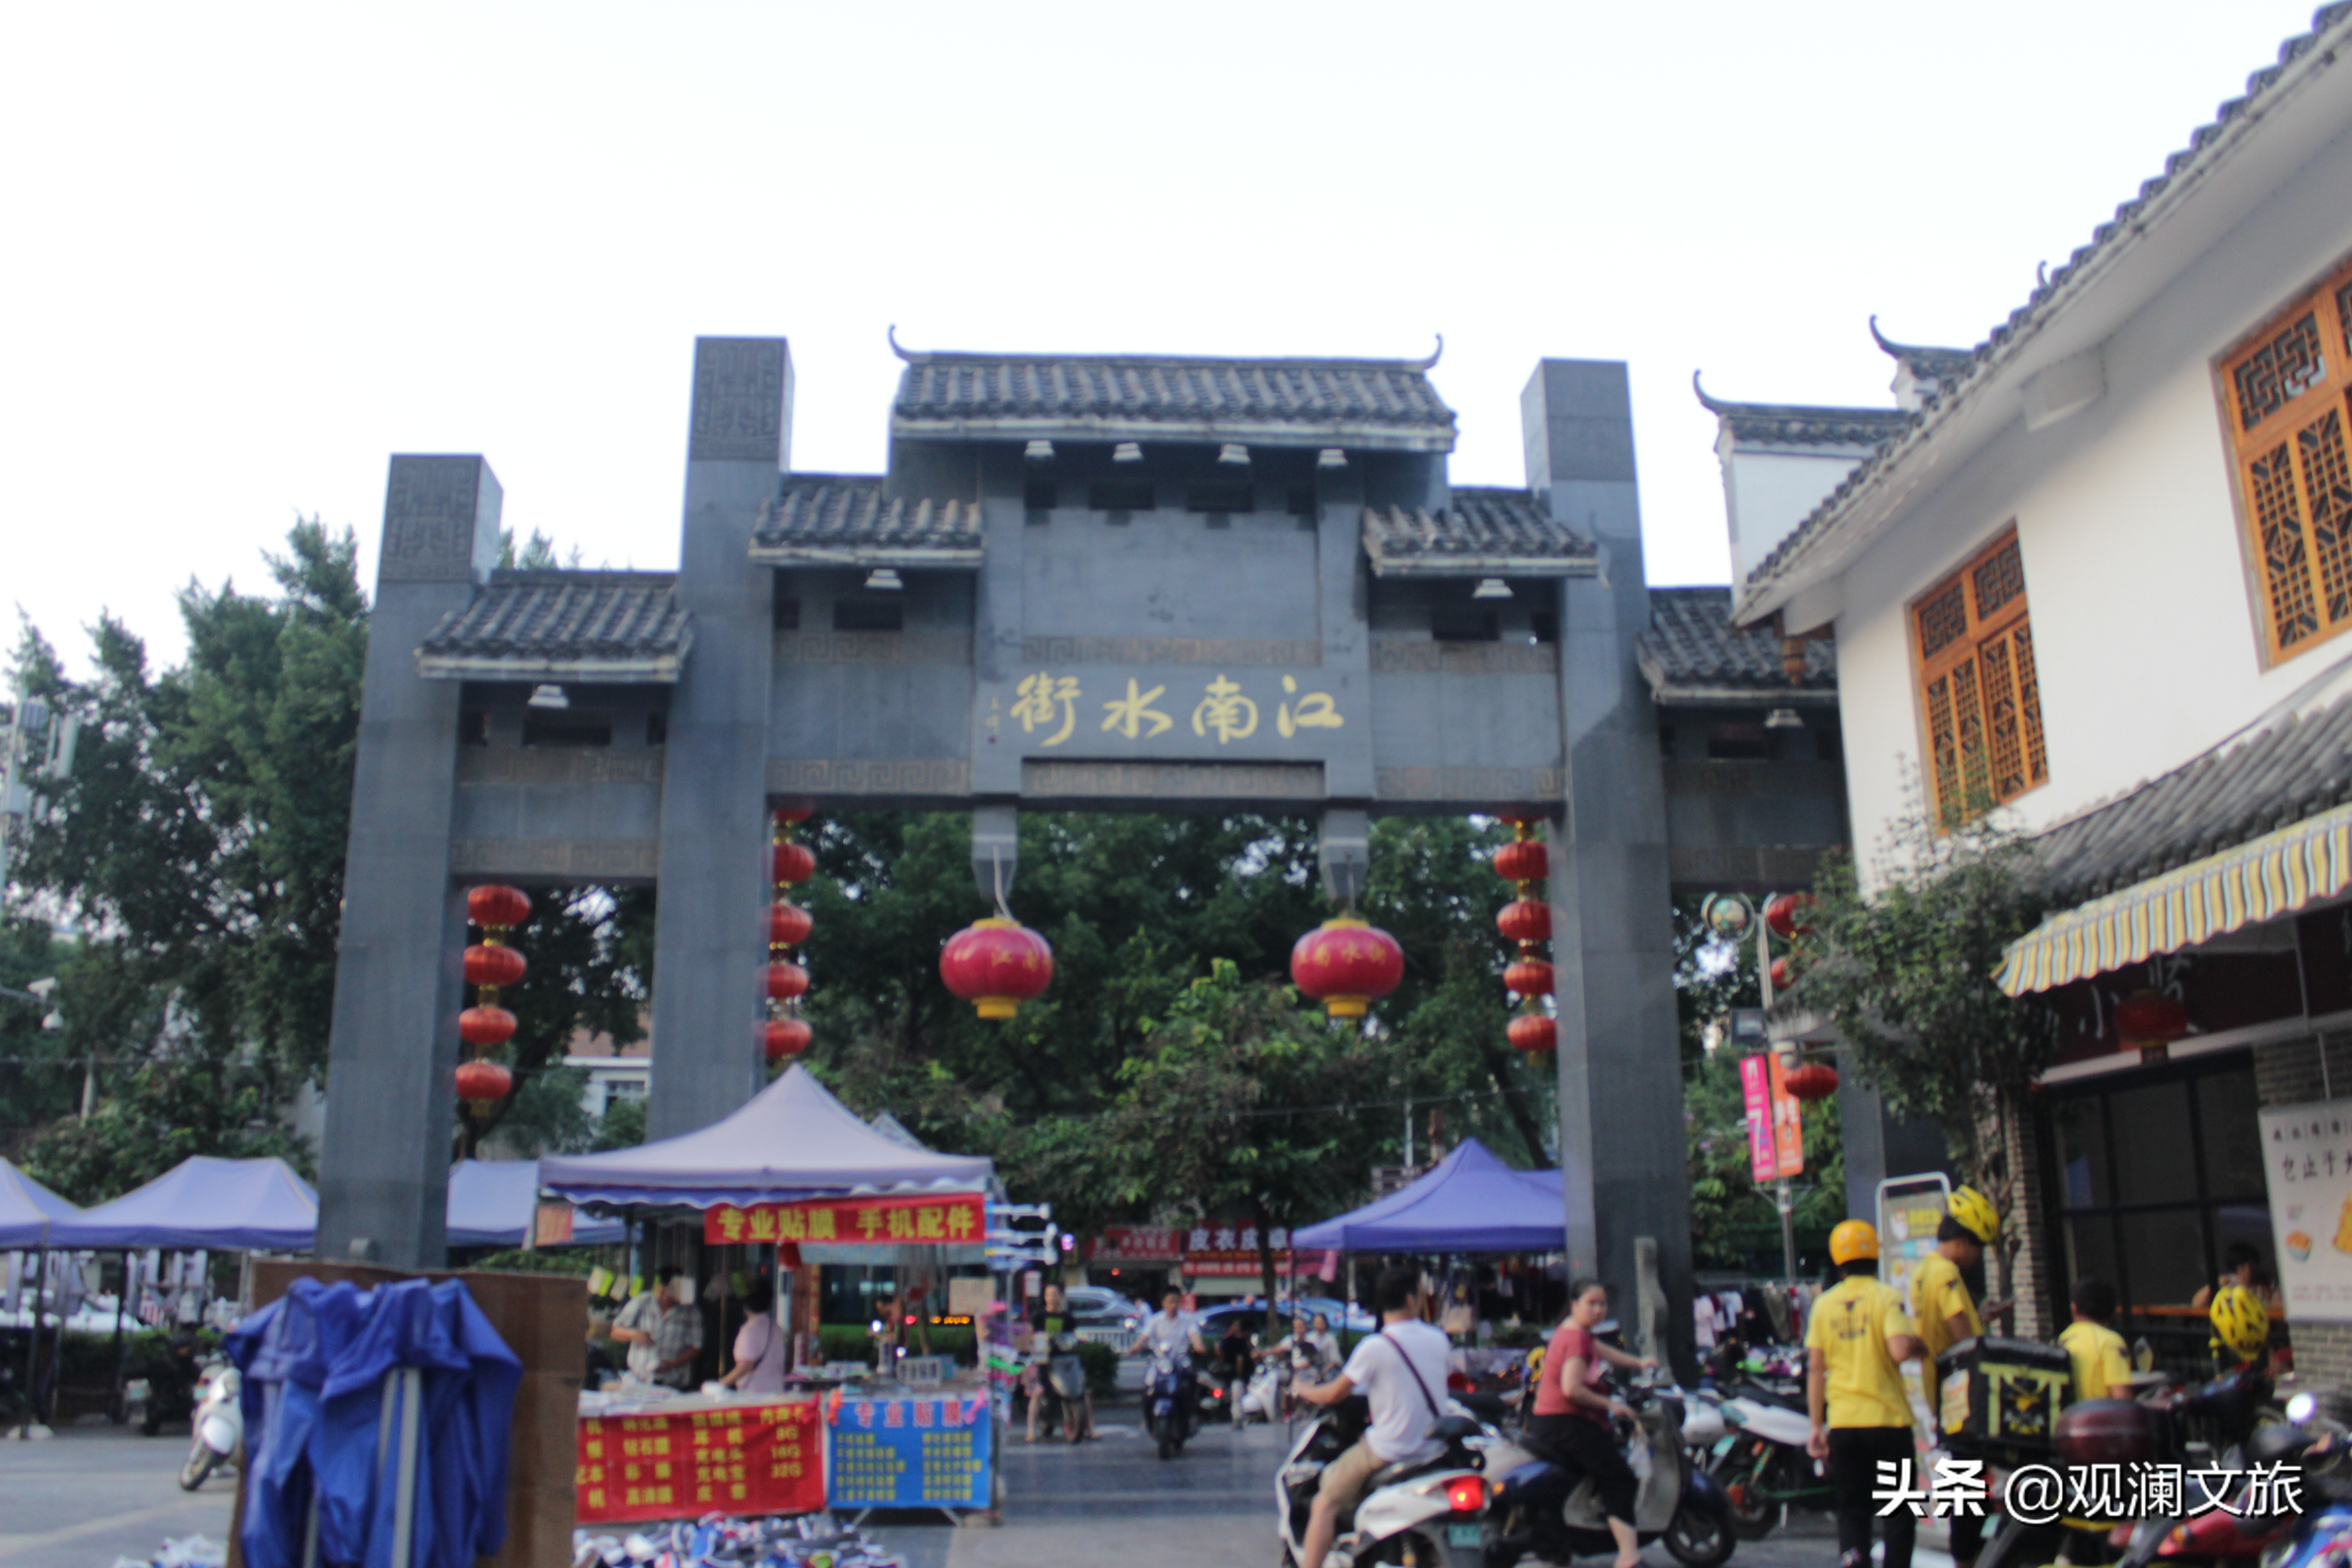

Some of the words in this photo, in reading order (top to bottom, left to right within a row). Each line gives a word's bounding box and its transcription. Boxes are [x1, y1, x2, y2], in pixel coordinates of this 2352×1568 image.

[717, 1207, 836, 1240] 专业贴膜
[856, 1205, 975, 1239] 手机配件
[853, 1401, 964, 1428] 专业贴膜
[776, 1424, 799, 1441] 8G
